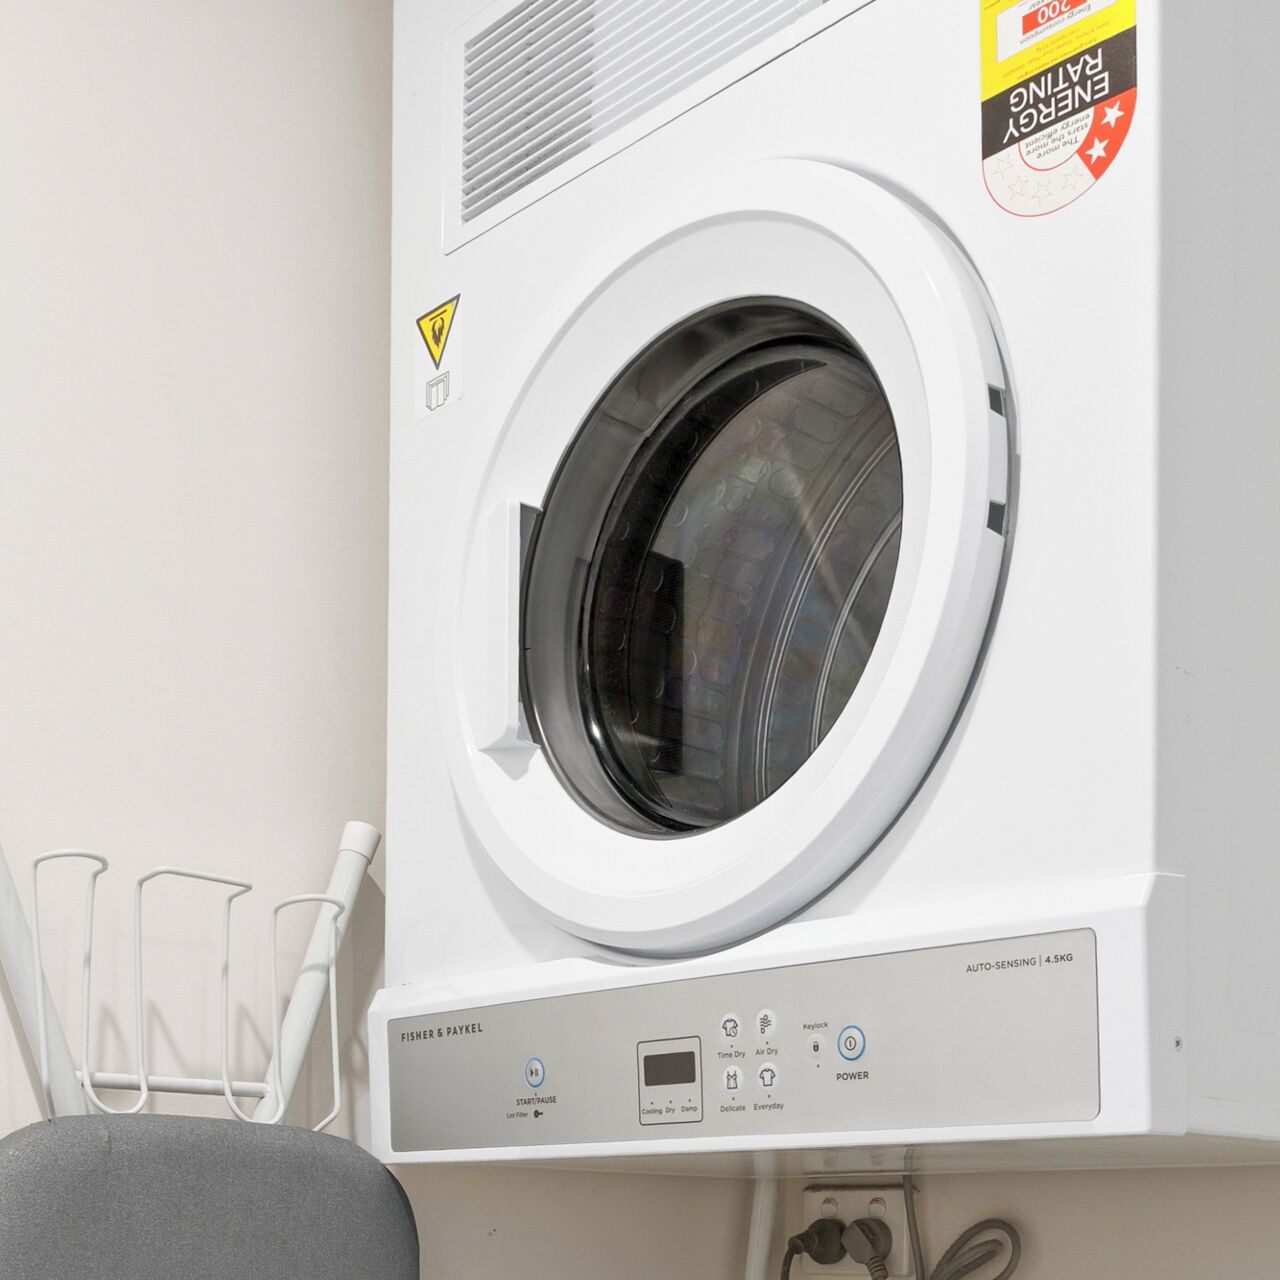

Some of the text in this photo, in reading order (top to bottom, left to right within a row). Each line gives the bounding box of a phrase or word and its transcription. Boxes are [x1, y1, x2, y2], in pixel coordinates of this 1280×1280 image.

[1037, 0, 1071, 24] 200
[1066, 4, 1092, 21] Energy
[1020, 18, 1066, 45] consumption
[1010, 48, 1102, 113] RATING
[1002, 71, 1109, 144] ENERGY
[1025, 113, 1090, 149] energy efficient
[1026, 122, 1090, 157] stars the more
[1036, 136, 1080, 159] The more
[966, 953, 1073, 973] AUTO-SENSING 4.5KG
[401, 1022, 484, 1043] FISHER & PAYKEL
[802, 1021, 829, 1031] Keylock
[717, 1050, 746, 1060] Time Dry
[755, 1047, 778, 1057] Air Dry
[836, 1071, 870, 1081] POWER
[516, 1095, 557, 1107] START/PAUSE
[642, 1104, 698, 1116] Cooling Dry Damp
[720, 1103, 746, 1113] Delicate
[753, 1102, 784, 1113] Everyday
